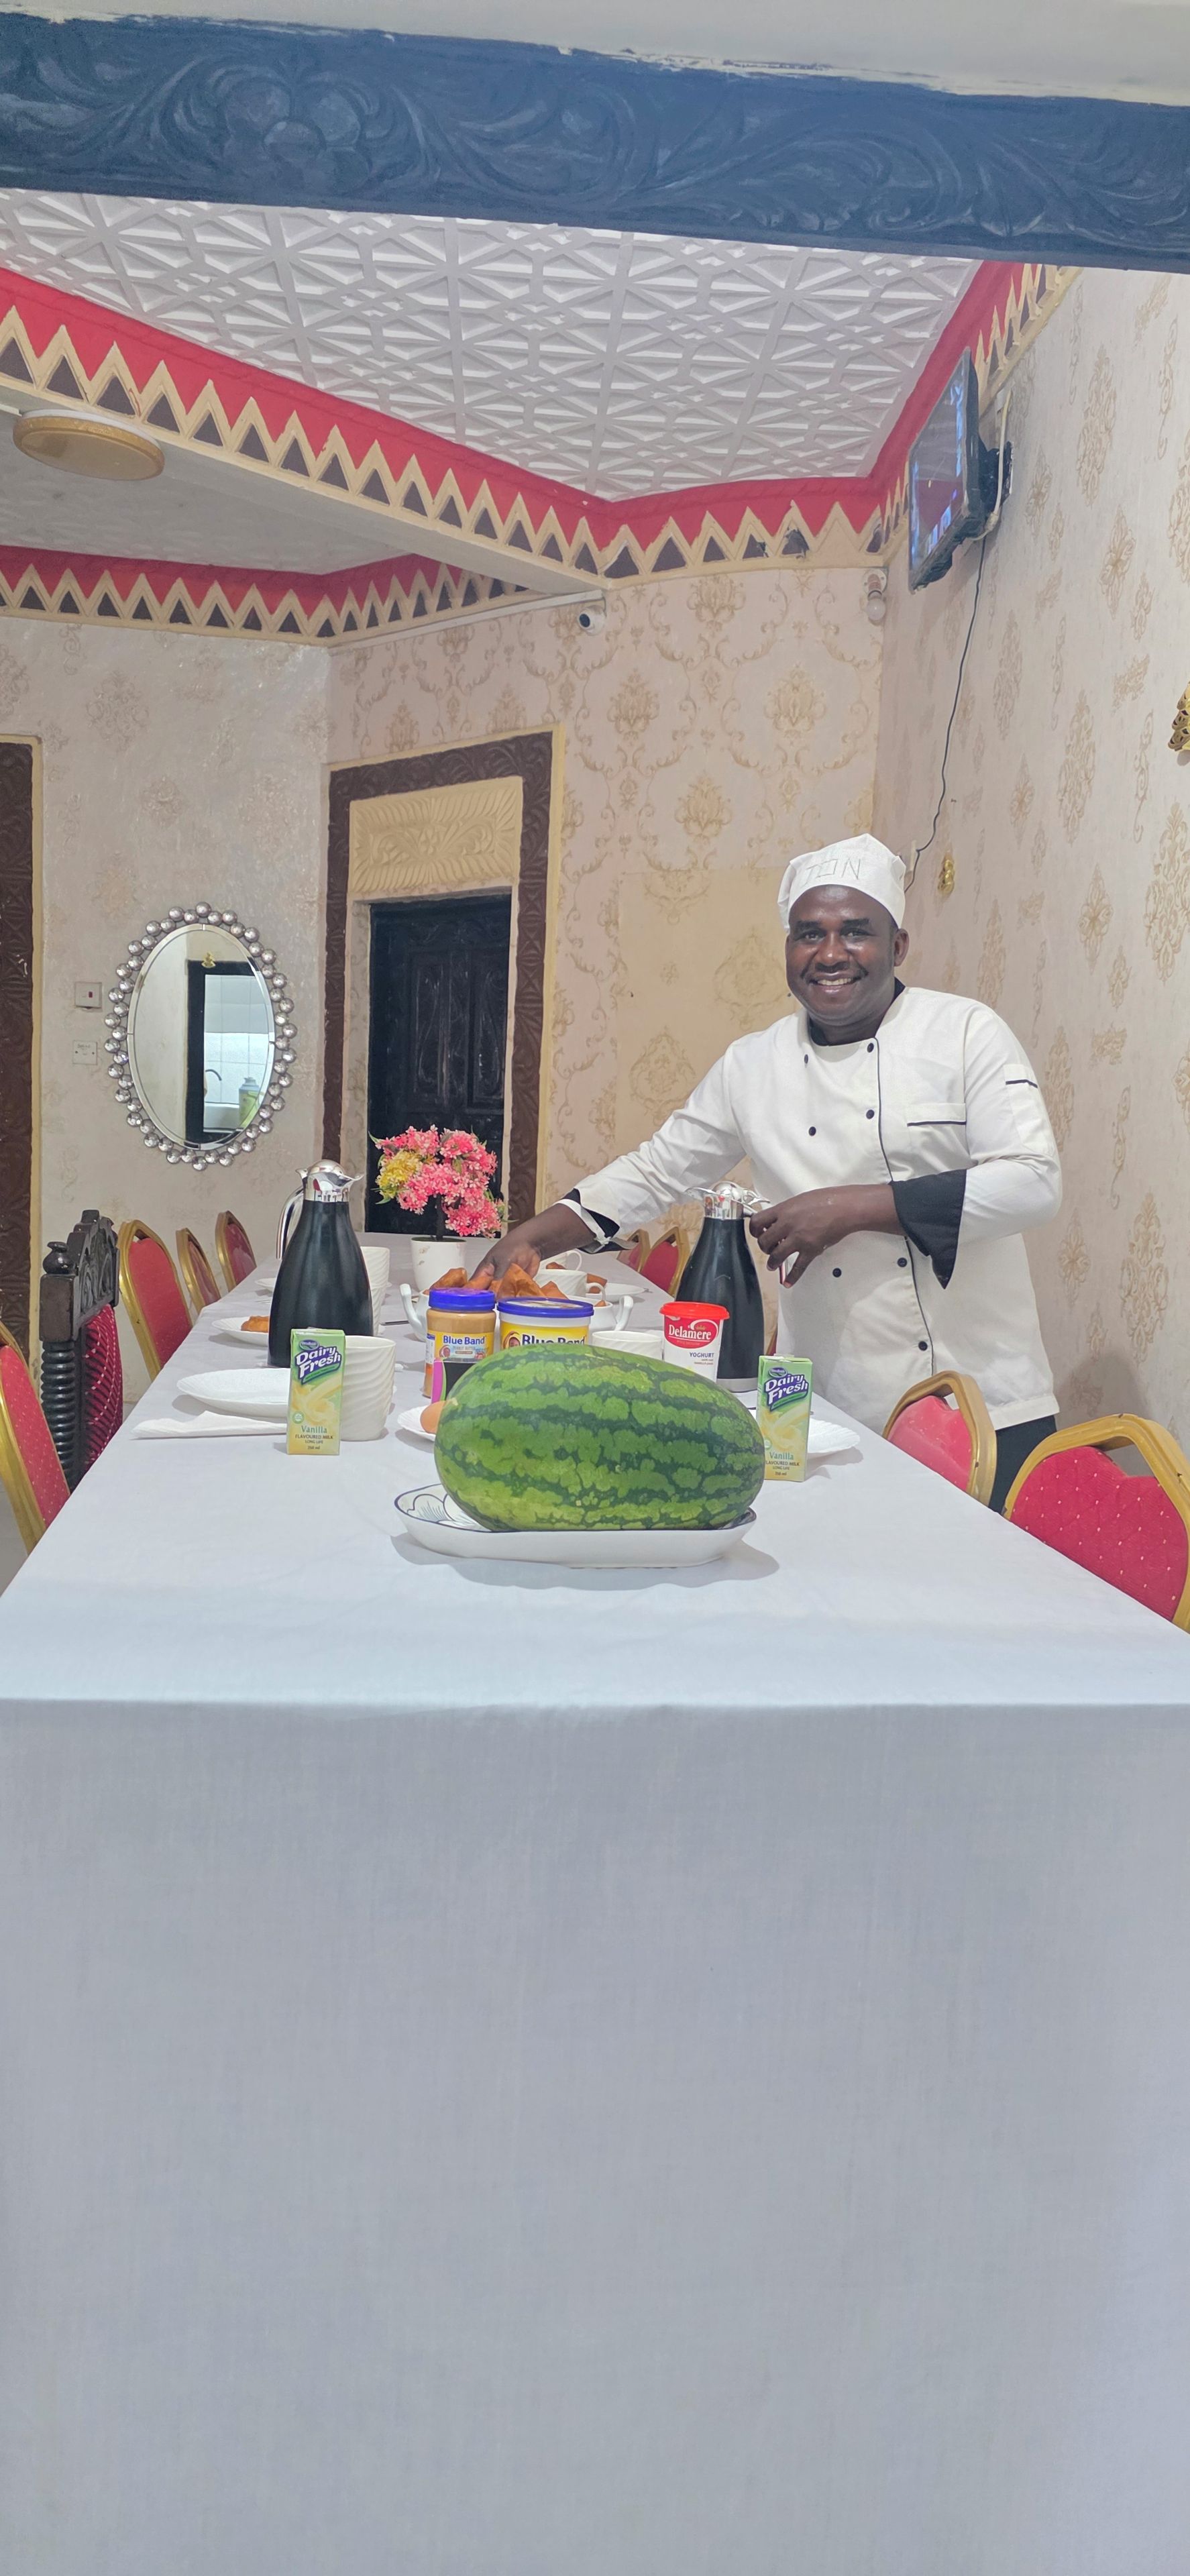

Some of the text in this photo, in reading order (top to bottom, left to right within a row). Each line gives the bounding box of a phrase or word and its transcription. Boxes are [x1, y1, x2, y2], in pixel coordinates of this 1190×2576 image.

[443, 1335, 485, 1345] Blue Band
[669, 1324, 711, 1340] Delamere
[557, 1336, 586, 1346] Bd
[296, 1346, 336, 1365] Dairy
[299, 1352, 341, 1379] Fresh
[765, 1375, 804, 1392] Dairy
[768, 1380, 808, 1405] Fresh
[301, 1425, 327, 1434] Vanilla
[769, 1451, 794, 1460] Vanilla
